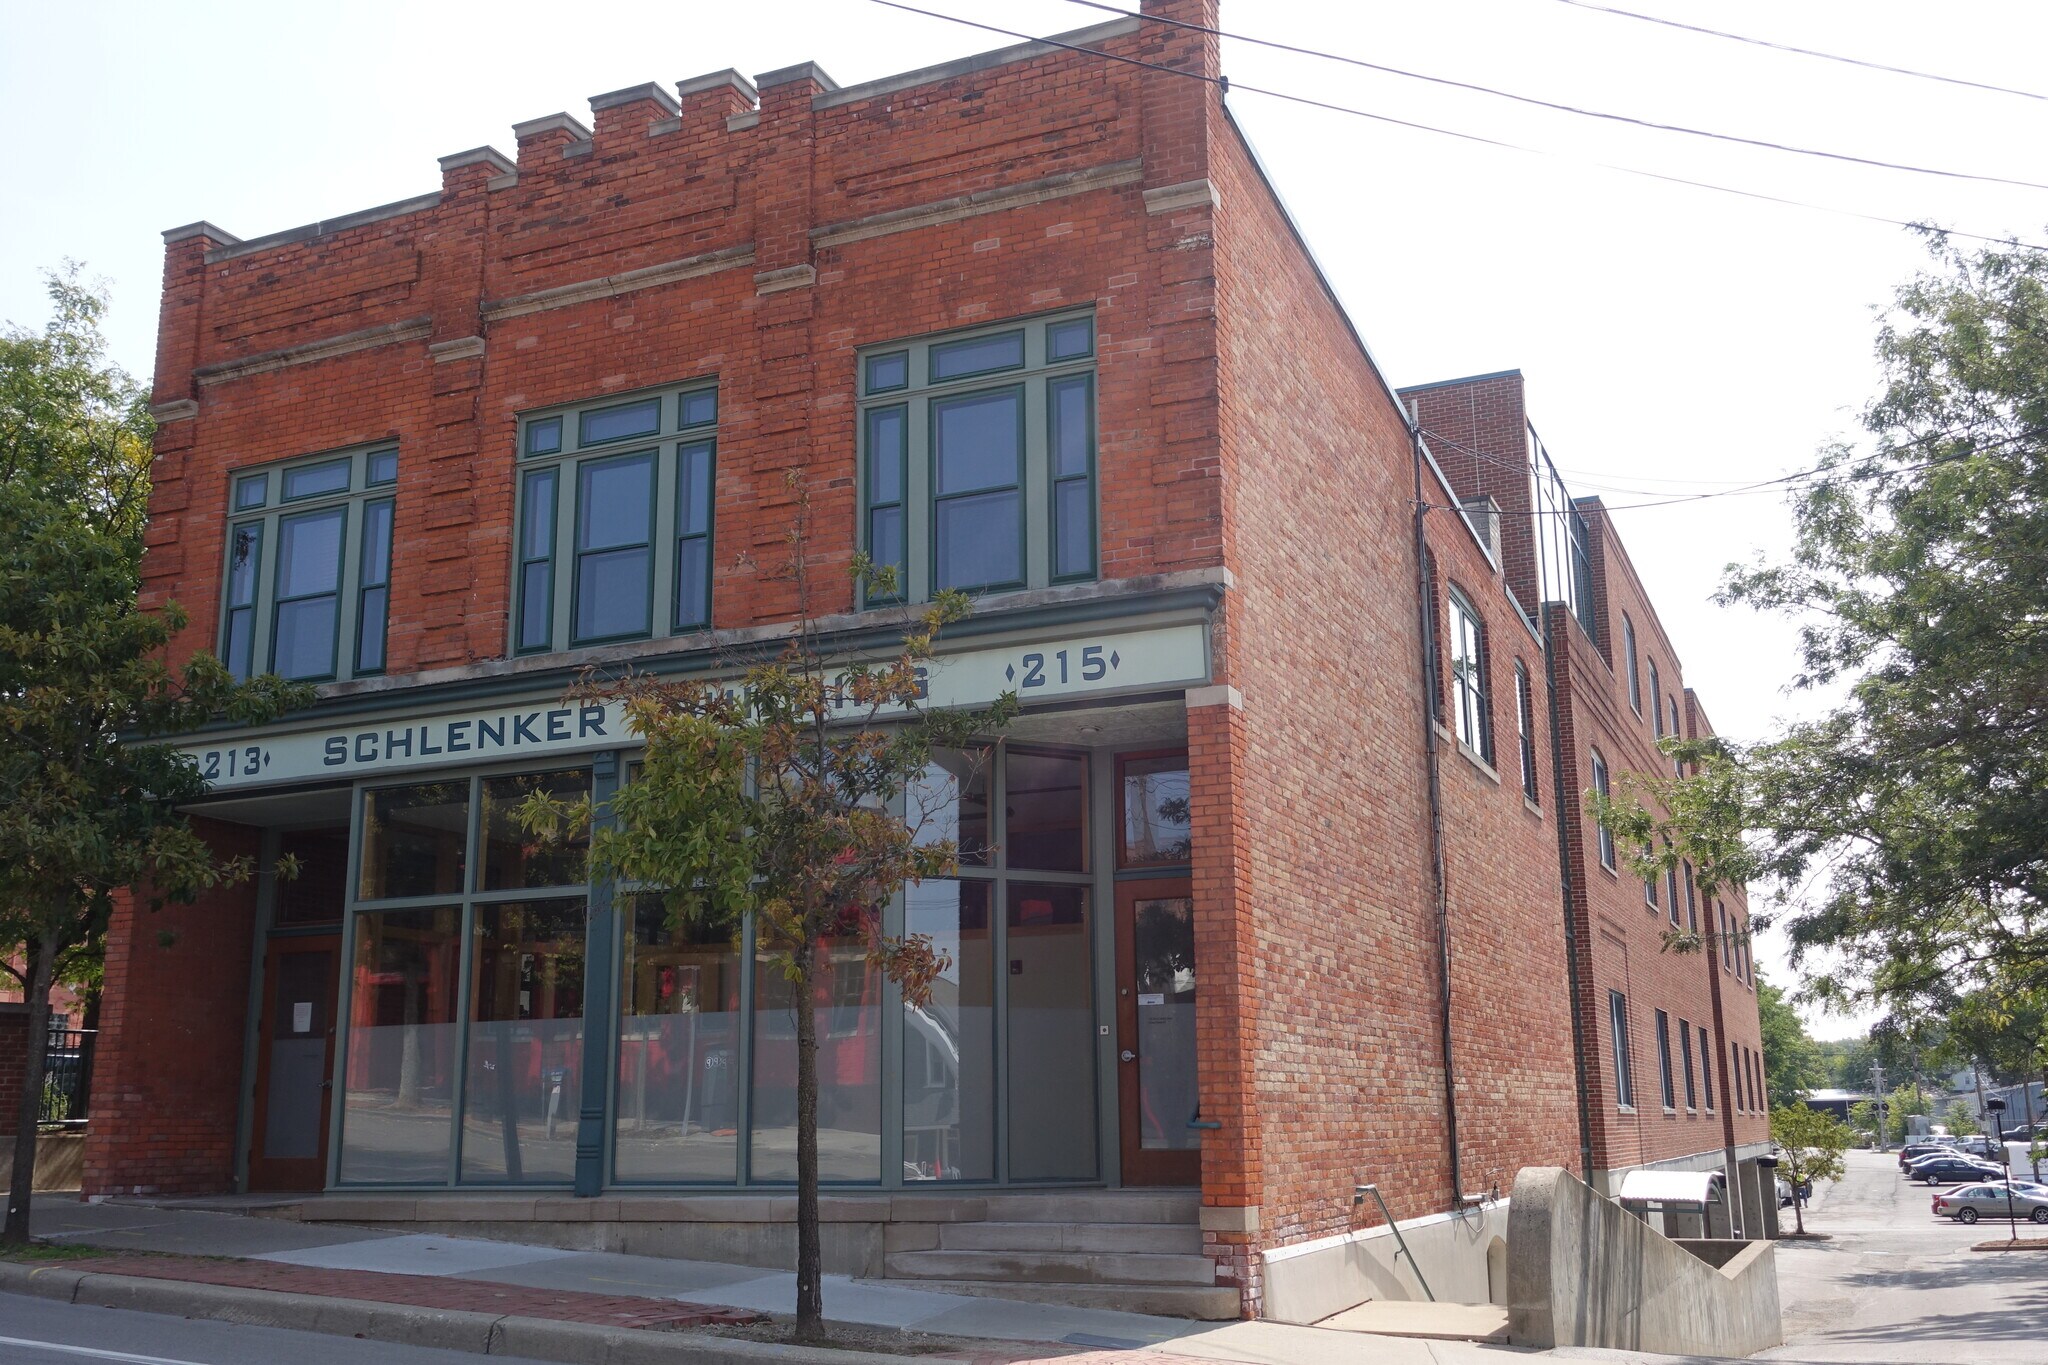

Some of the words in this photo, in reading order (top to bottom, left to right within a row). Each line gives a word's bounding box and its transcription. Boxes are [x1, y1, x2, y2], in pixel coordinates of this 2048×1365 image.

[204, 747, 261, 780] 213
[323, 706, 608, 766] SCHLENKER
[1022, 646, 1107, 688] 215
